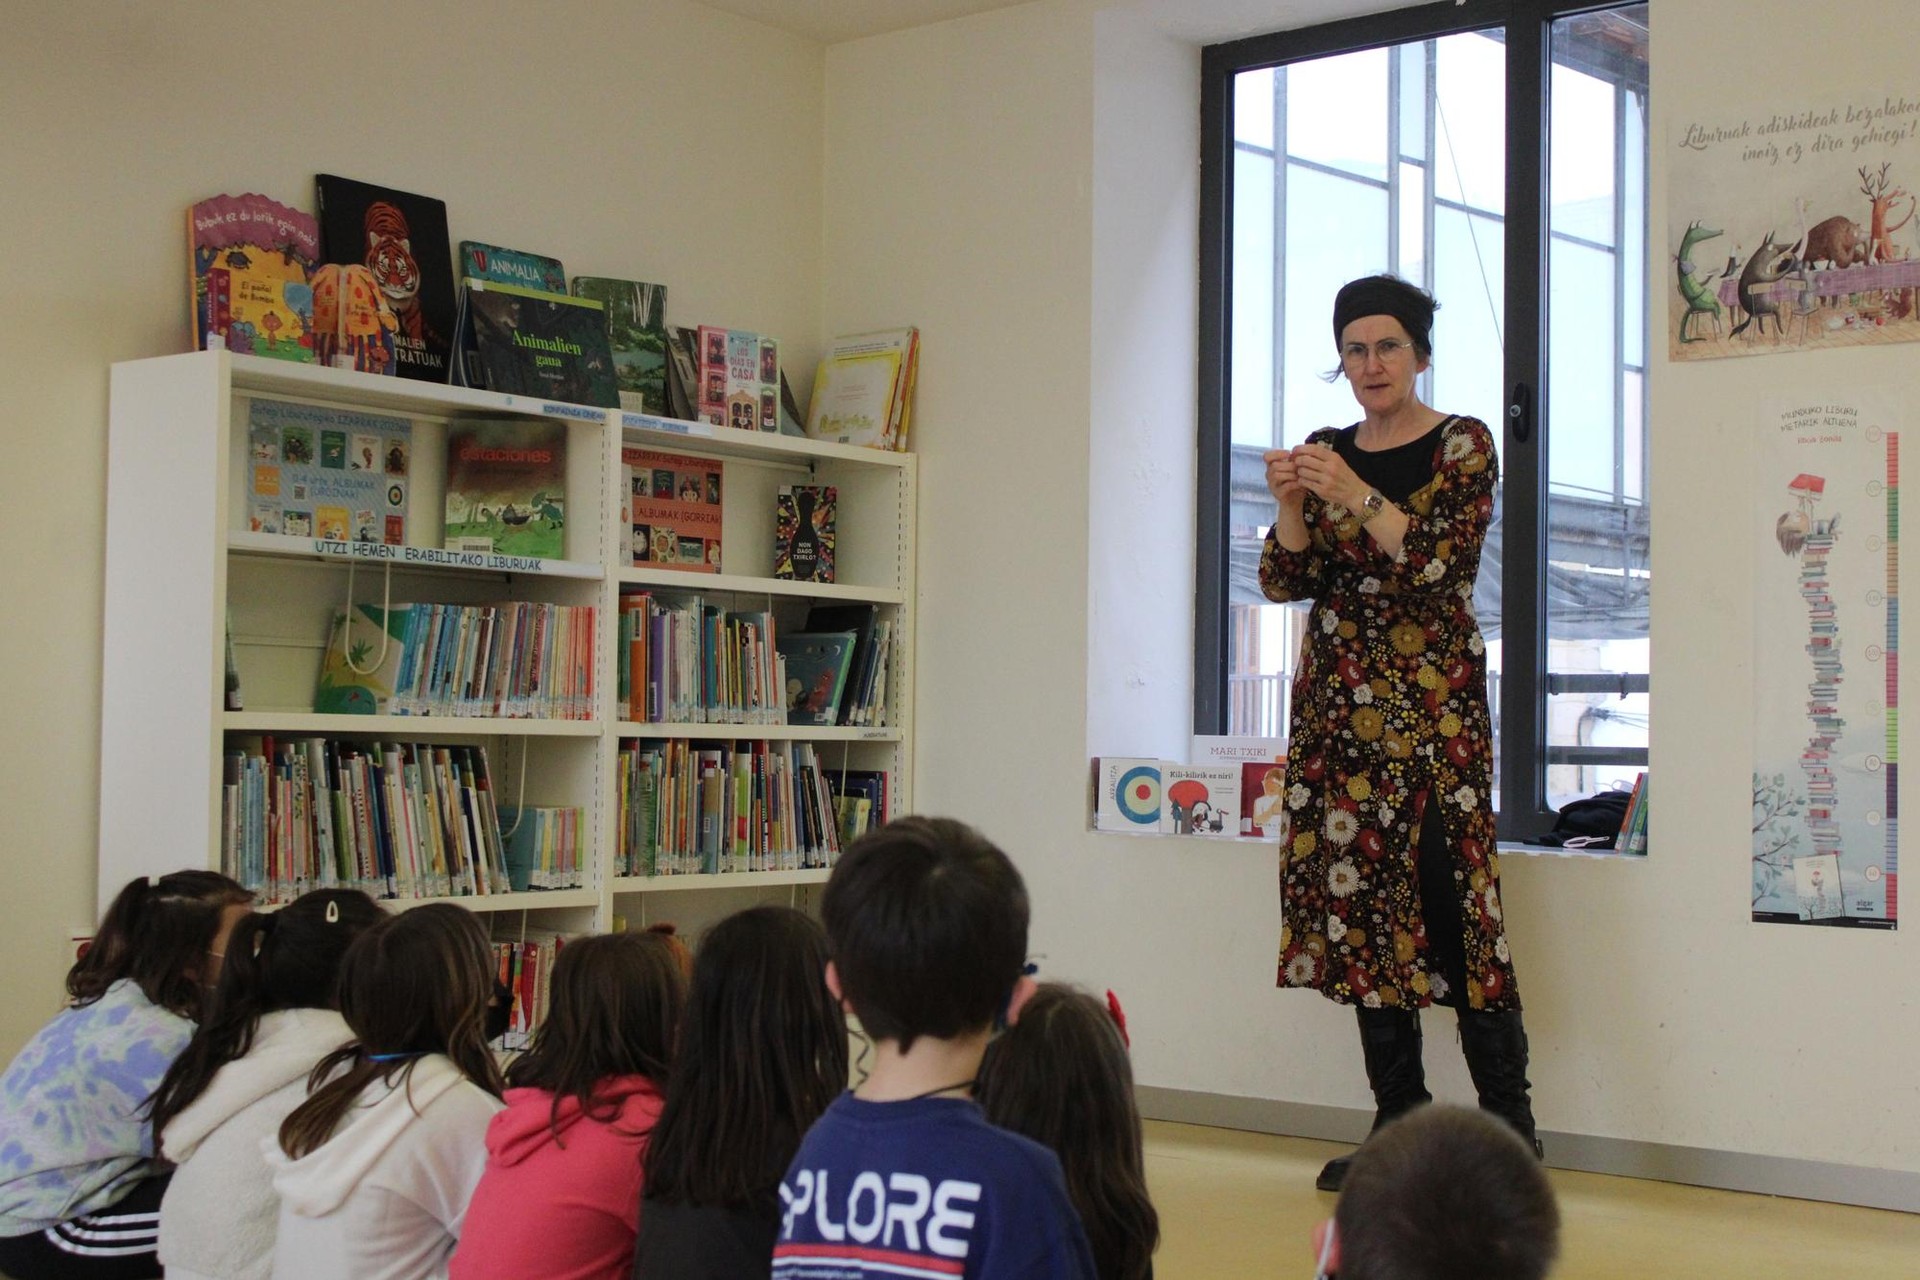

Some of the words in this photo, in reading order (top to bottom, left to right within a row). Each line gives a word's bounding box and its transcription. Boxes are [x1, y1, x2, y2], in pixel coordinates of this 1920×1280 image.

[1678, 121, 1750, 151] Liburuak
[1757, 108, 1839, 135] adiskideak
[1742, 141, 1778, 165] inoiz
[1786, 141, 1802, 164] ez
[1811, 133, 1844, 152] dira
[1852, 119, 1918, 152] gehiegi!
[226, 212, 237, 222] ez
[240, 210, 250, 221] du
[277, 219, 296, 236] egin
[491, 259, 541, 282] ANIMALIA
[512, 329, 582, 356] Animalien
[535, 355, 563, 368] gaua
[731, 366, 755, 381] CASA
[1826, 405, 1858, 417] LIBURU
[639, 507, 679, 519] ALBUMAK
[315, 541, 347, 554] UTZI
[352, 543, 395, 558] HEMEN
[405, 547, 483, 566] ERABILITAKO
[487, 555, 541, 571] LIBURUAK
[1210, 747, 1237, 756] MARI
[1240, 747, 1267, 756] TXIKI
[1169, 771, 1208, 779] Kili-kilirik
